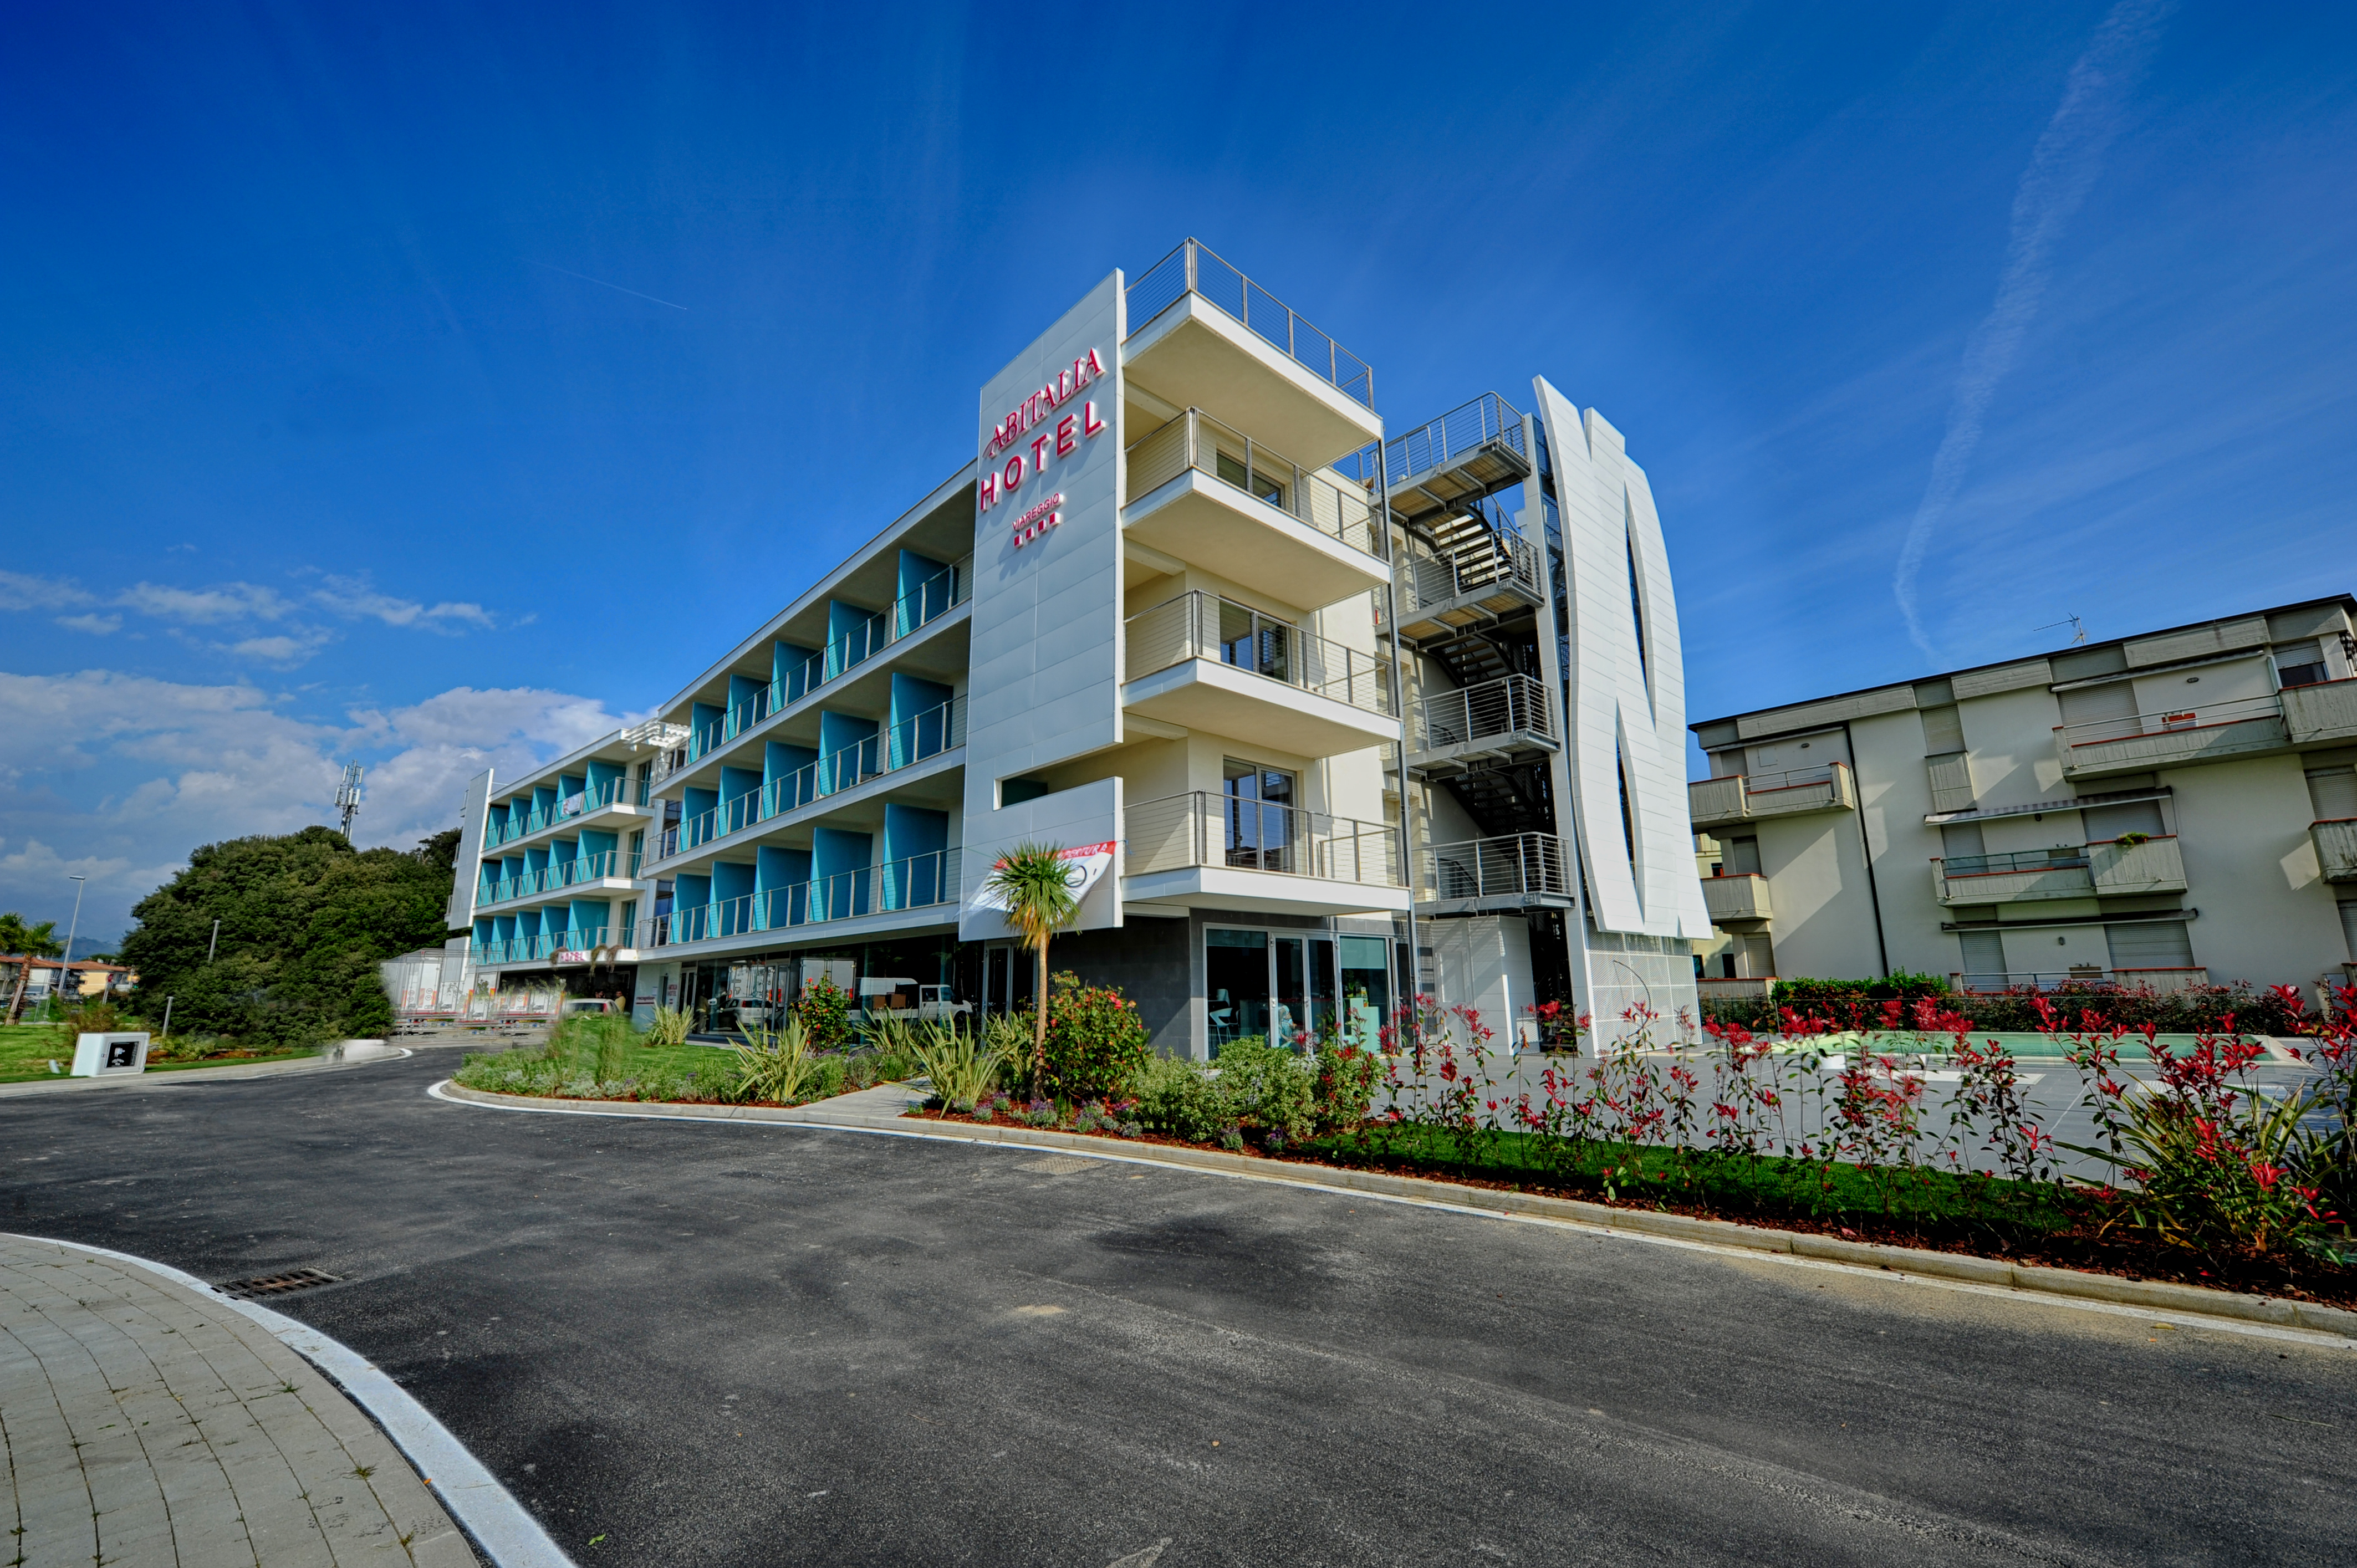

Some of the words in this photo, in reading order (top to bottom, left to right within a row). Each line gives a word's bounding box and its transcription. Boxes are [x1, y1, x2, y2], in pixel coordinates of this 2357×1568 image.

[980, 400, 1104, 512] HOTEL
[983, 347, 1104, 458] ABITALIA
[1012, 493, 1061, 532] VIAREGGIO
